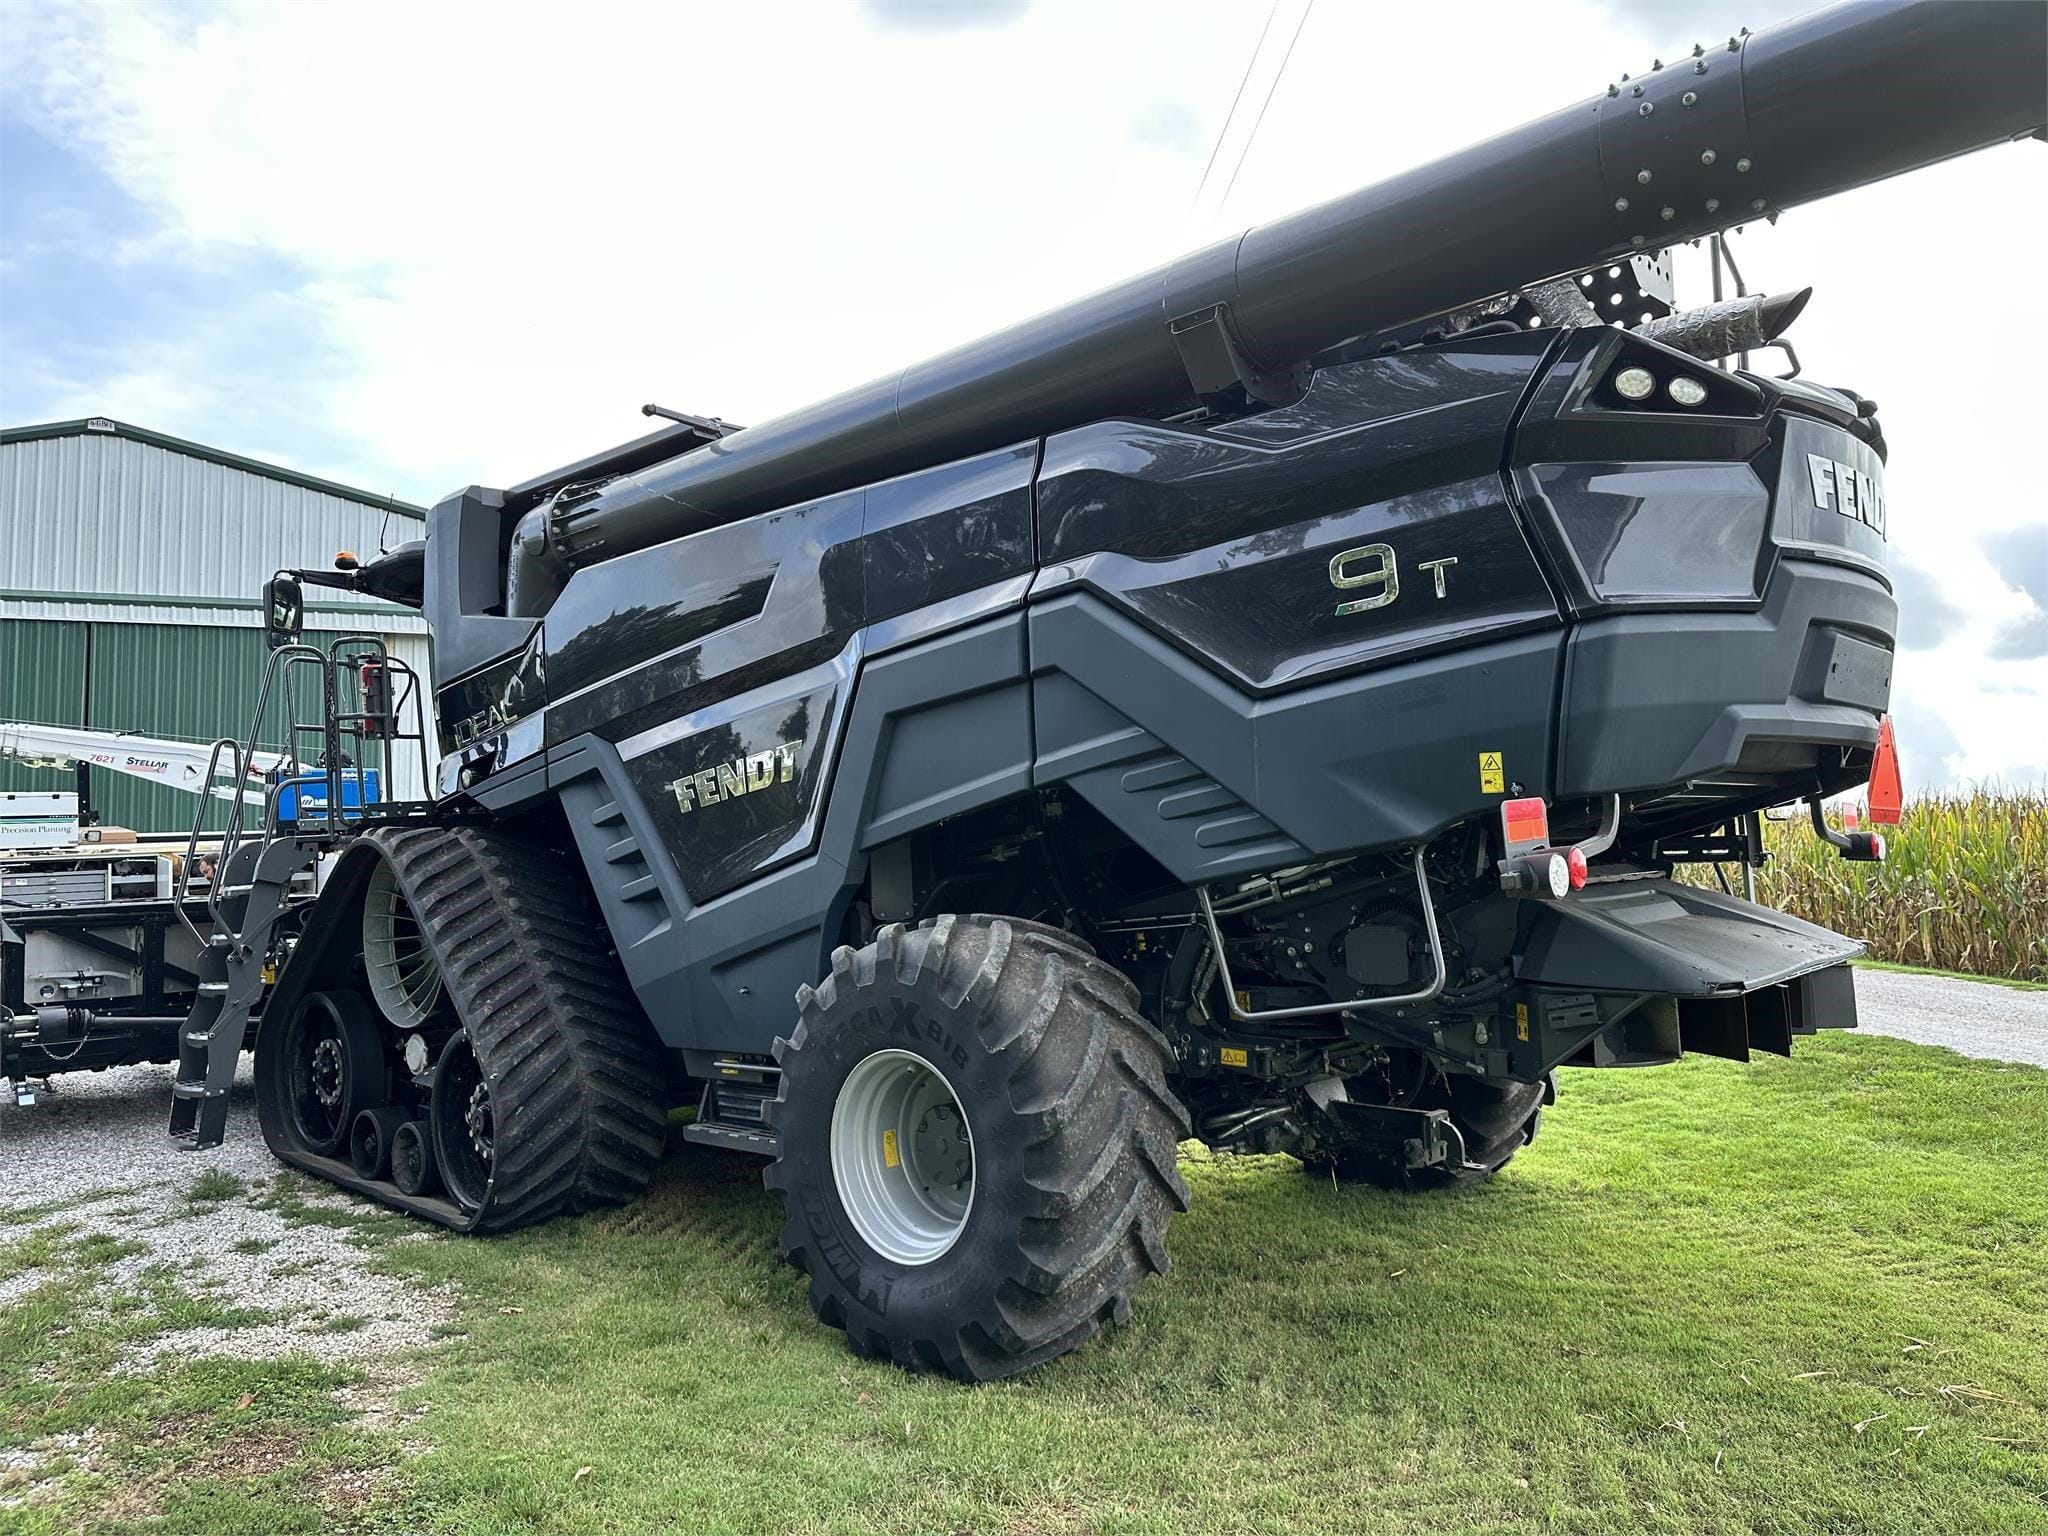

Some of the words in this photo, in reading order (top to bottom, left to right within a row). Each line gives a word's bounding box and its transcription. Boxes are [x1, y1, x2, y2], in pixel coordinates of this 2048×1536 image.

[1806, 453, 1886, 542] FEND
[1329, 543, 1399, 616] 9
[1418, 556, 1458, 599] T
[89, 754, 115, 764] 7621
[126, 756, 169, 769] STELLAR
[673, 740, 802, 813] FENDT
[1, 826, 37, 834] Precision
[38, 825, 72, 834] Planting
